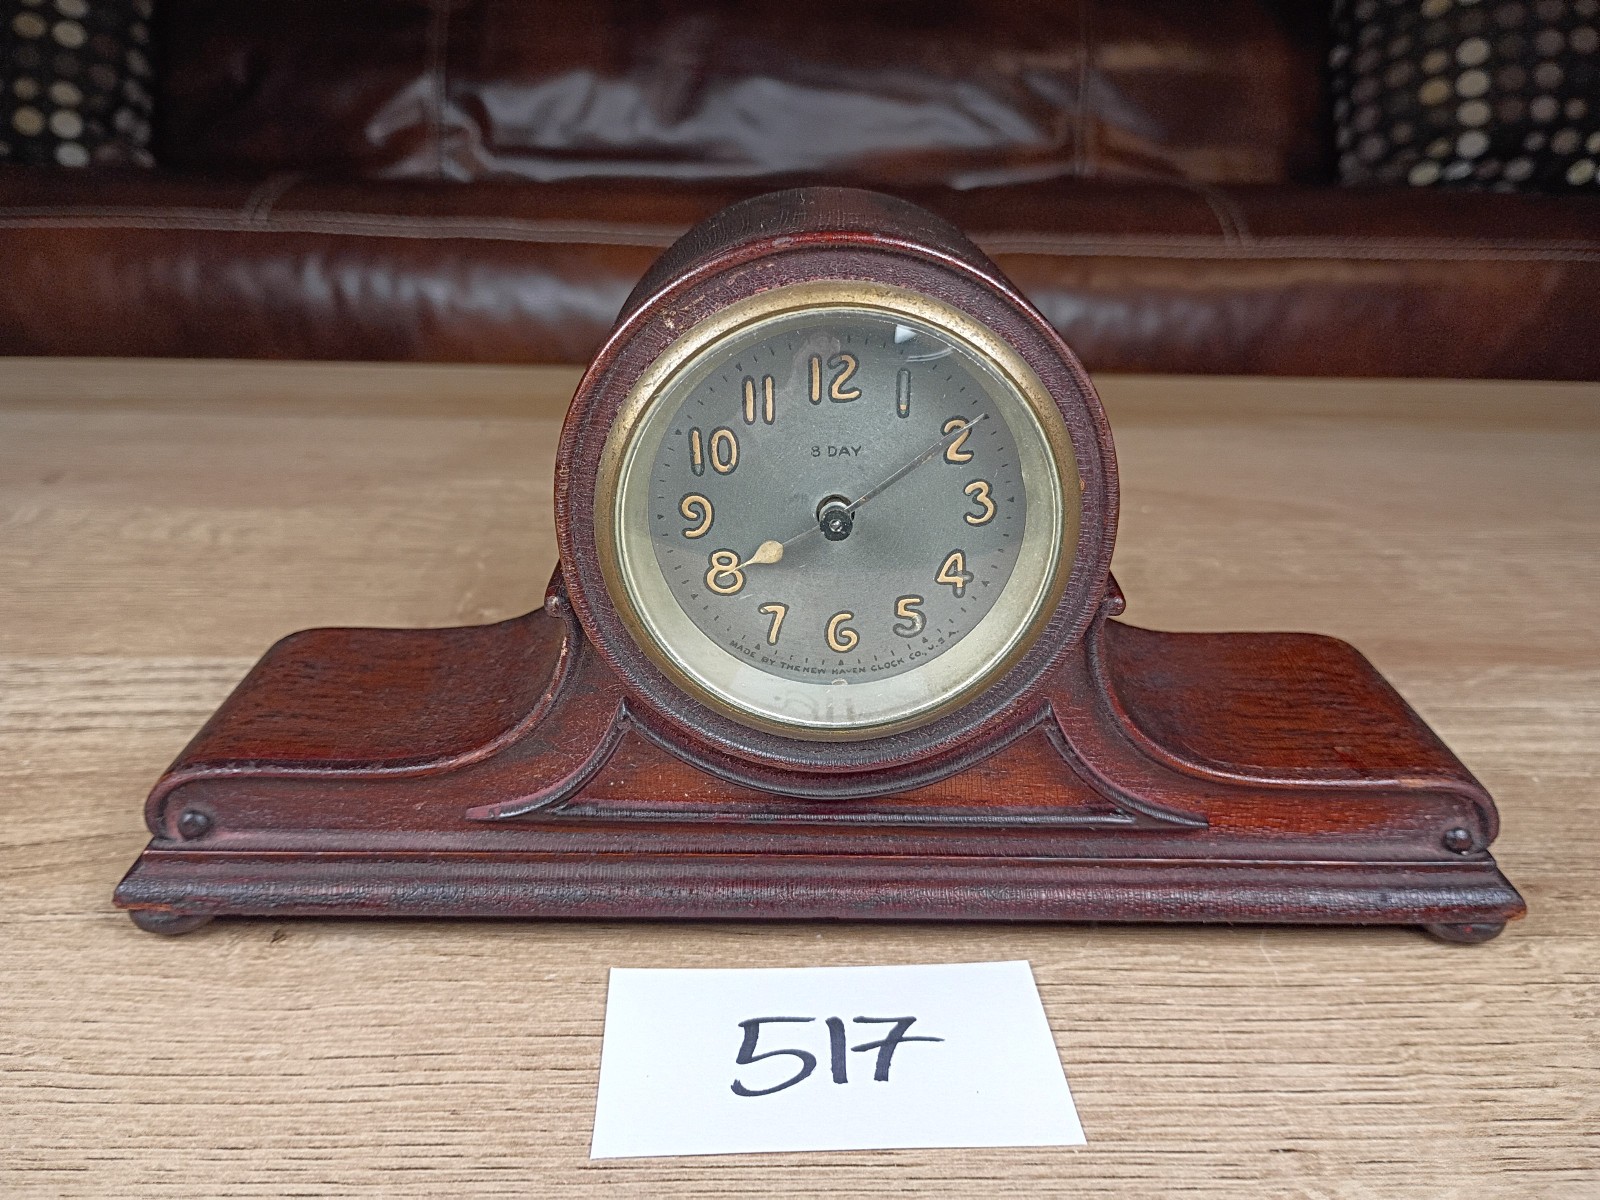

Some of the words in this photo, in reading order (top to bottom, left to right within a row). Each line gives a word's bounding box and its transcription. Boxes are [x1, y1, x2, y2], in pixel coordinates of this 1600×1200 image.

[742, 374, 776, 425] 11
[807, 352, 862, 405] 12
[896, 367, 911, 418] 1
[688, 424, 740, 476] 10
[811, 445, 821, 457] 8
[827, 445, 862, 457] DAY
[941, 415, 974, 465] 2
[677, 492, 714, 539] 9
[963, 478, 998, 527] 3
[704, 548, 746, 596] 8
[935, 550, 974, 597] 4
[758, 601, 789, 645] 7
[825, 610, 860, 654] 6
[893, 594, 926, 637] 5
[729, 640, 756, 658] MADE
[761, 656, 776, 666] BY
[780, 661, 801, 672] THE
[802, 666, 827, 675] NEW
[831, 666, 867, 675] HAVEN
[870, 657, 905, 672] CLOCK
[927, 630, 960, 651] U.SA.
[730, 1015, 946, 1097] 517
